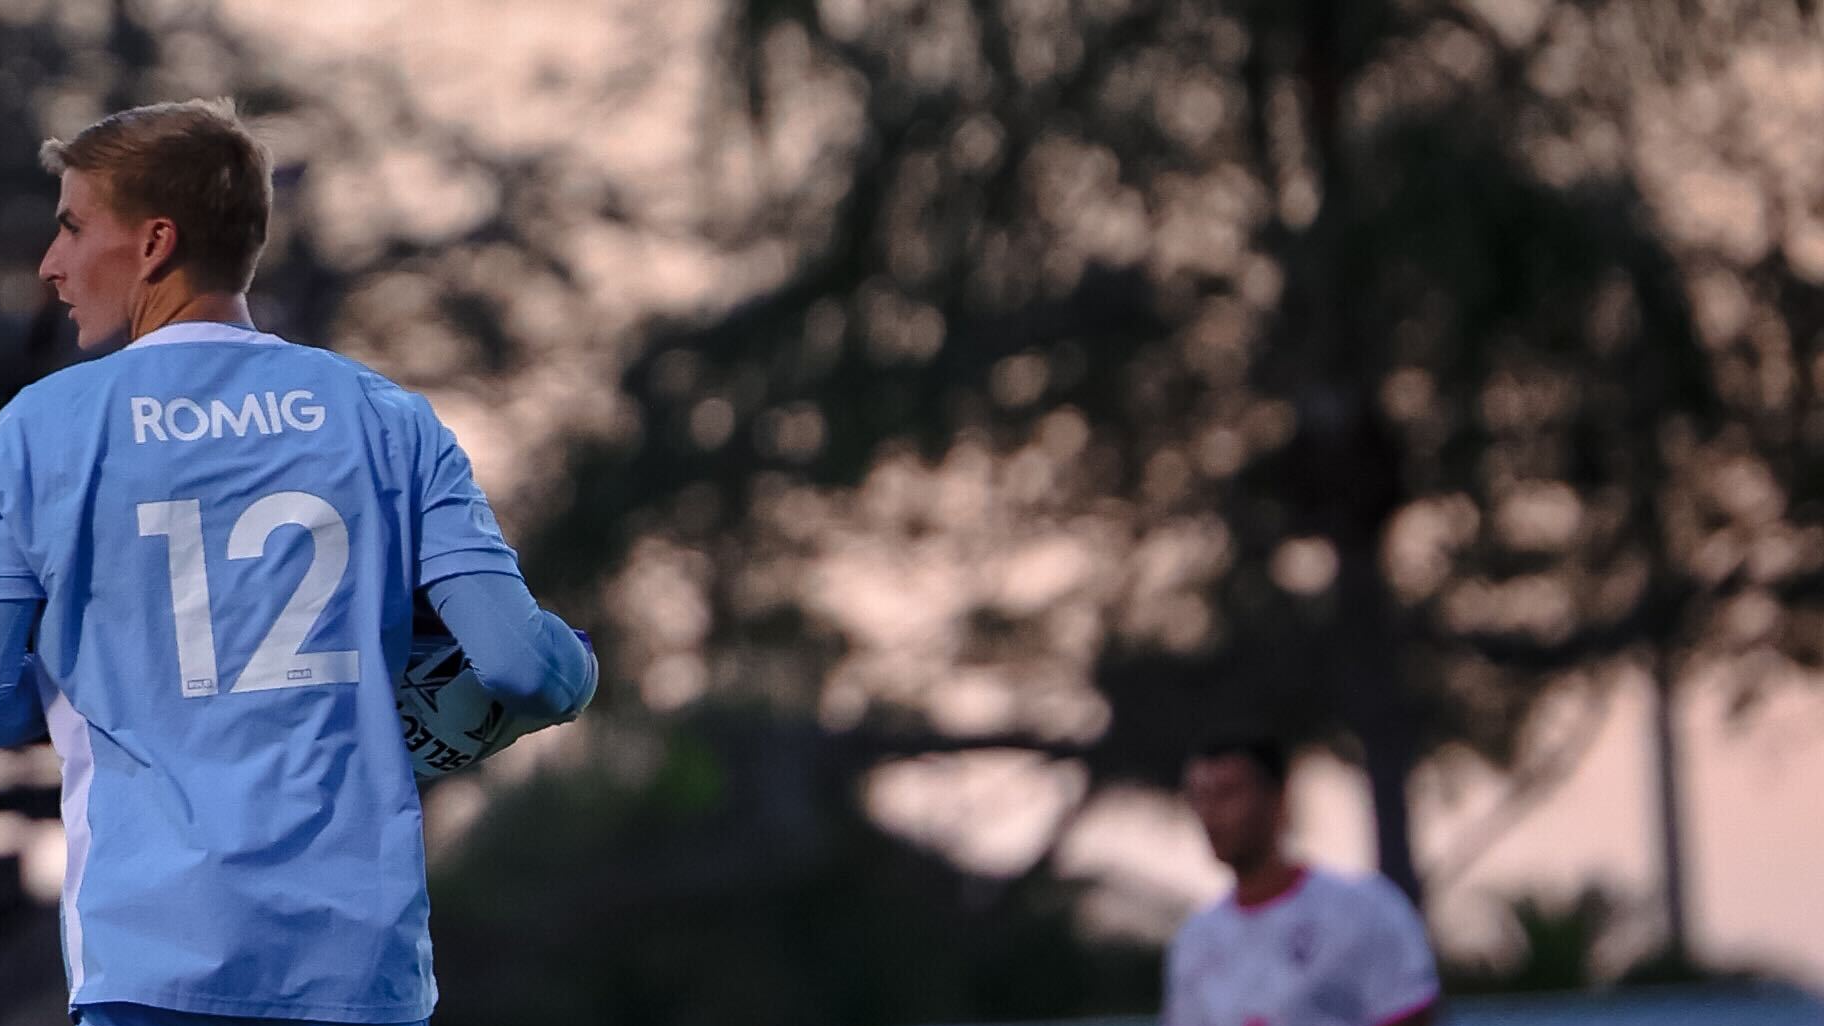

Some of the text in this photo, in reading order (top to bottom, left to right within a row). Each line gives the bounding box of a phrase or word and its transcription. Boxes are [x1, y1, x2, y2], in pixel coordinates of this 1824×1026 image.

[132, 390, 325, 442] ROMIG
[138, 491, 359, 698] 12
[396, 701, 473, 771] SELEC
